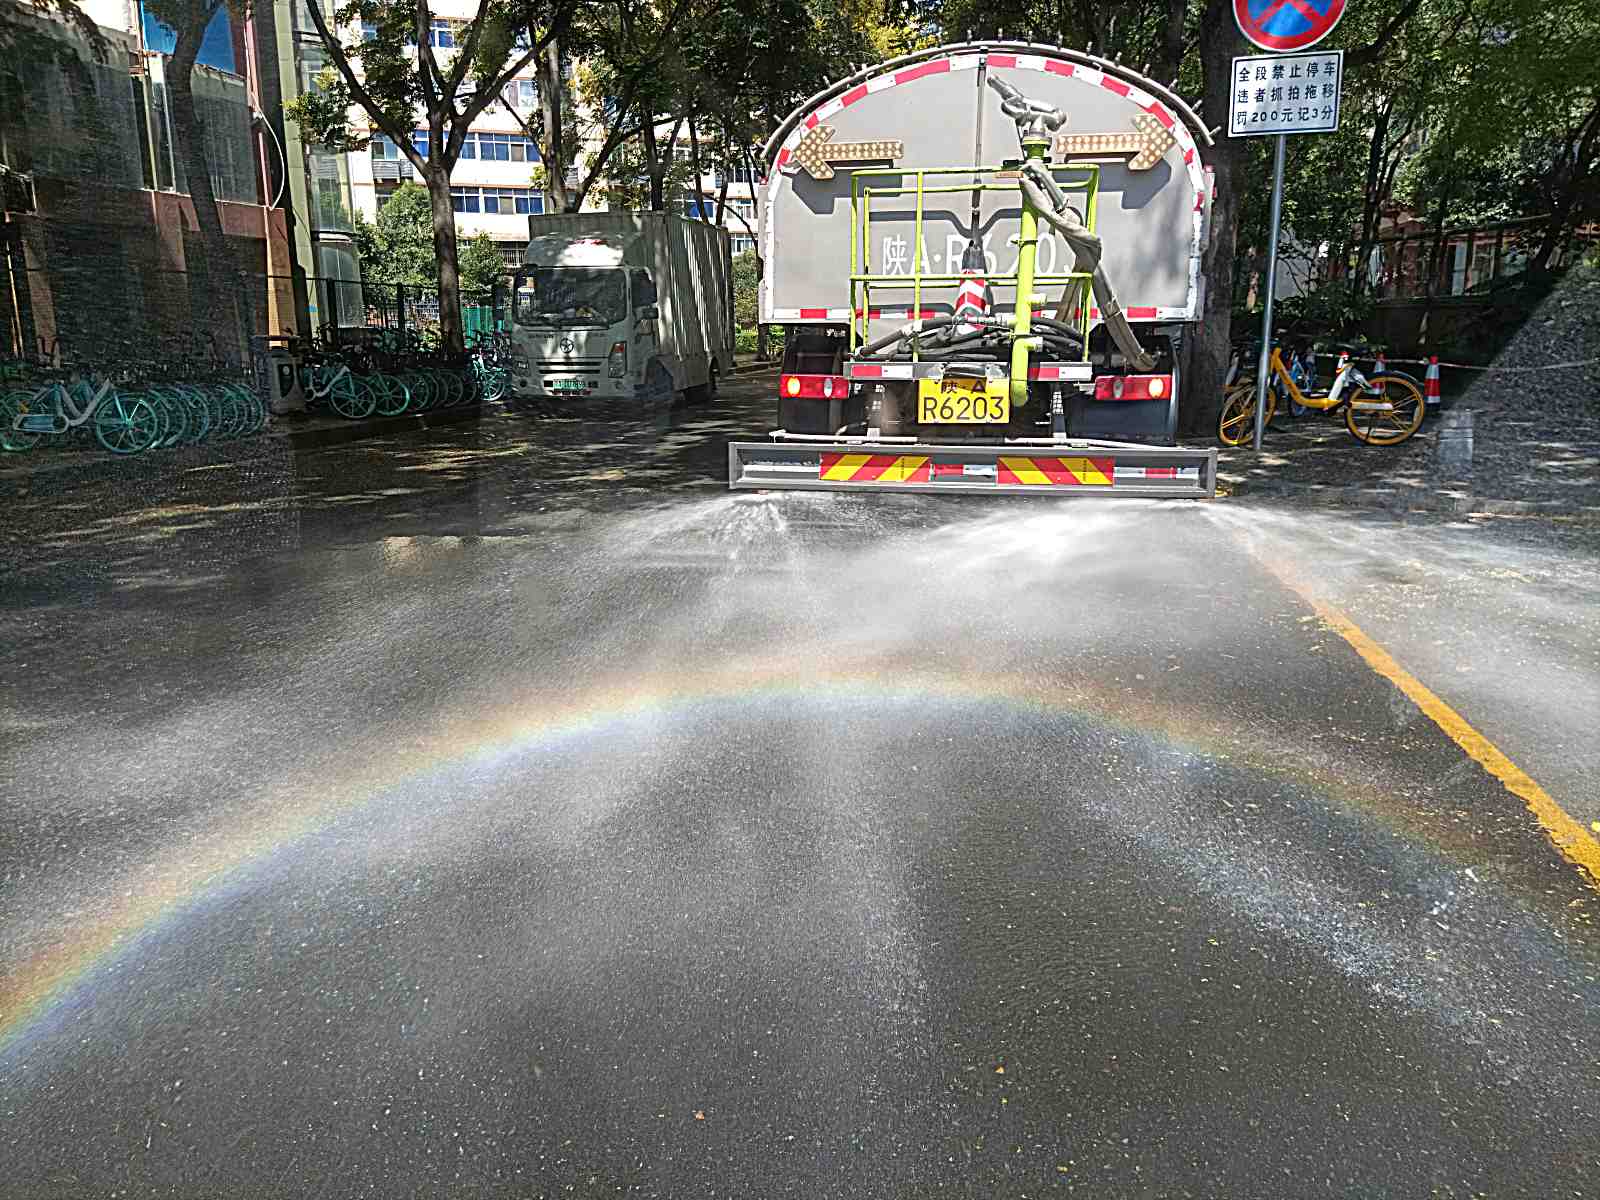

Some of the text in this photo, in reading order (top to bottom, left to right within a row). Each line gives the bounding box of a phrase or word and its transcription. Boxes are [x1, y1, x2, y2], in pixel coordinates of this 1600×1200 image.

[1238, 62, 1336, 83] 全段禁止停车
[1237, 83, 1335, 105] 违者抓拍拖移
[923, 396, 1004, 420] R6203
